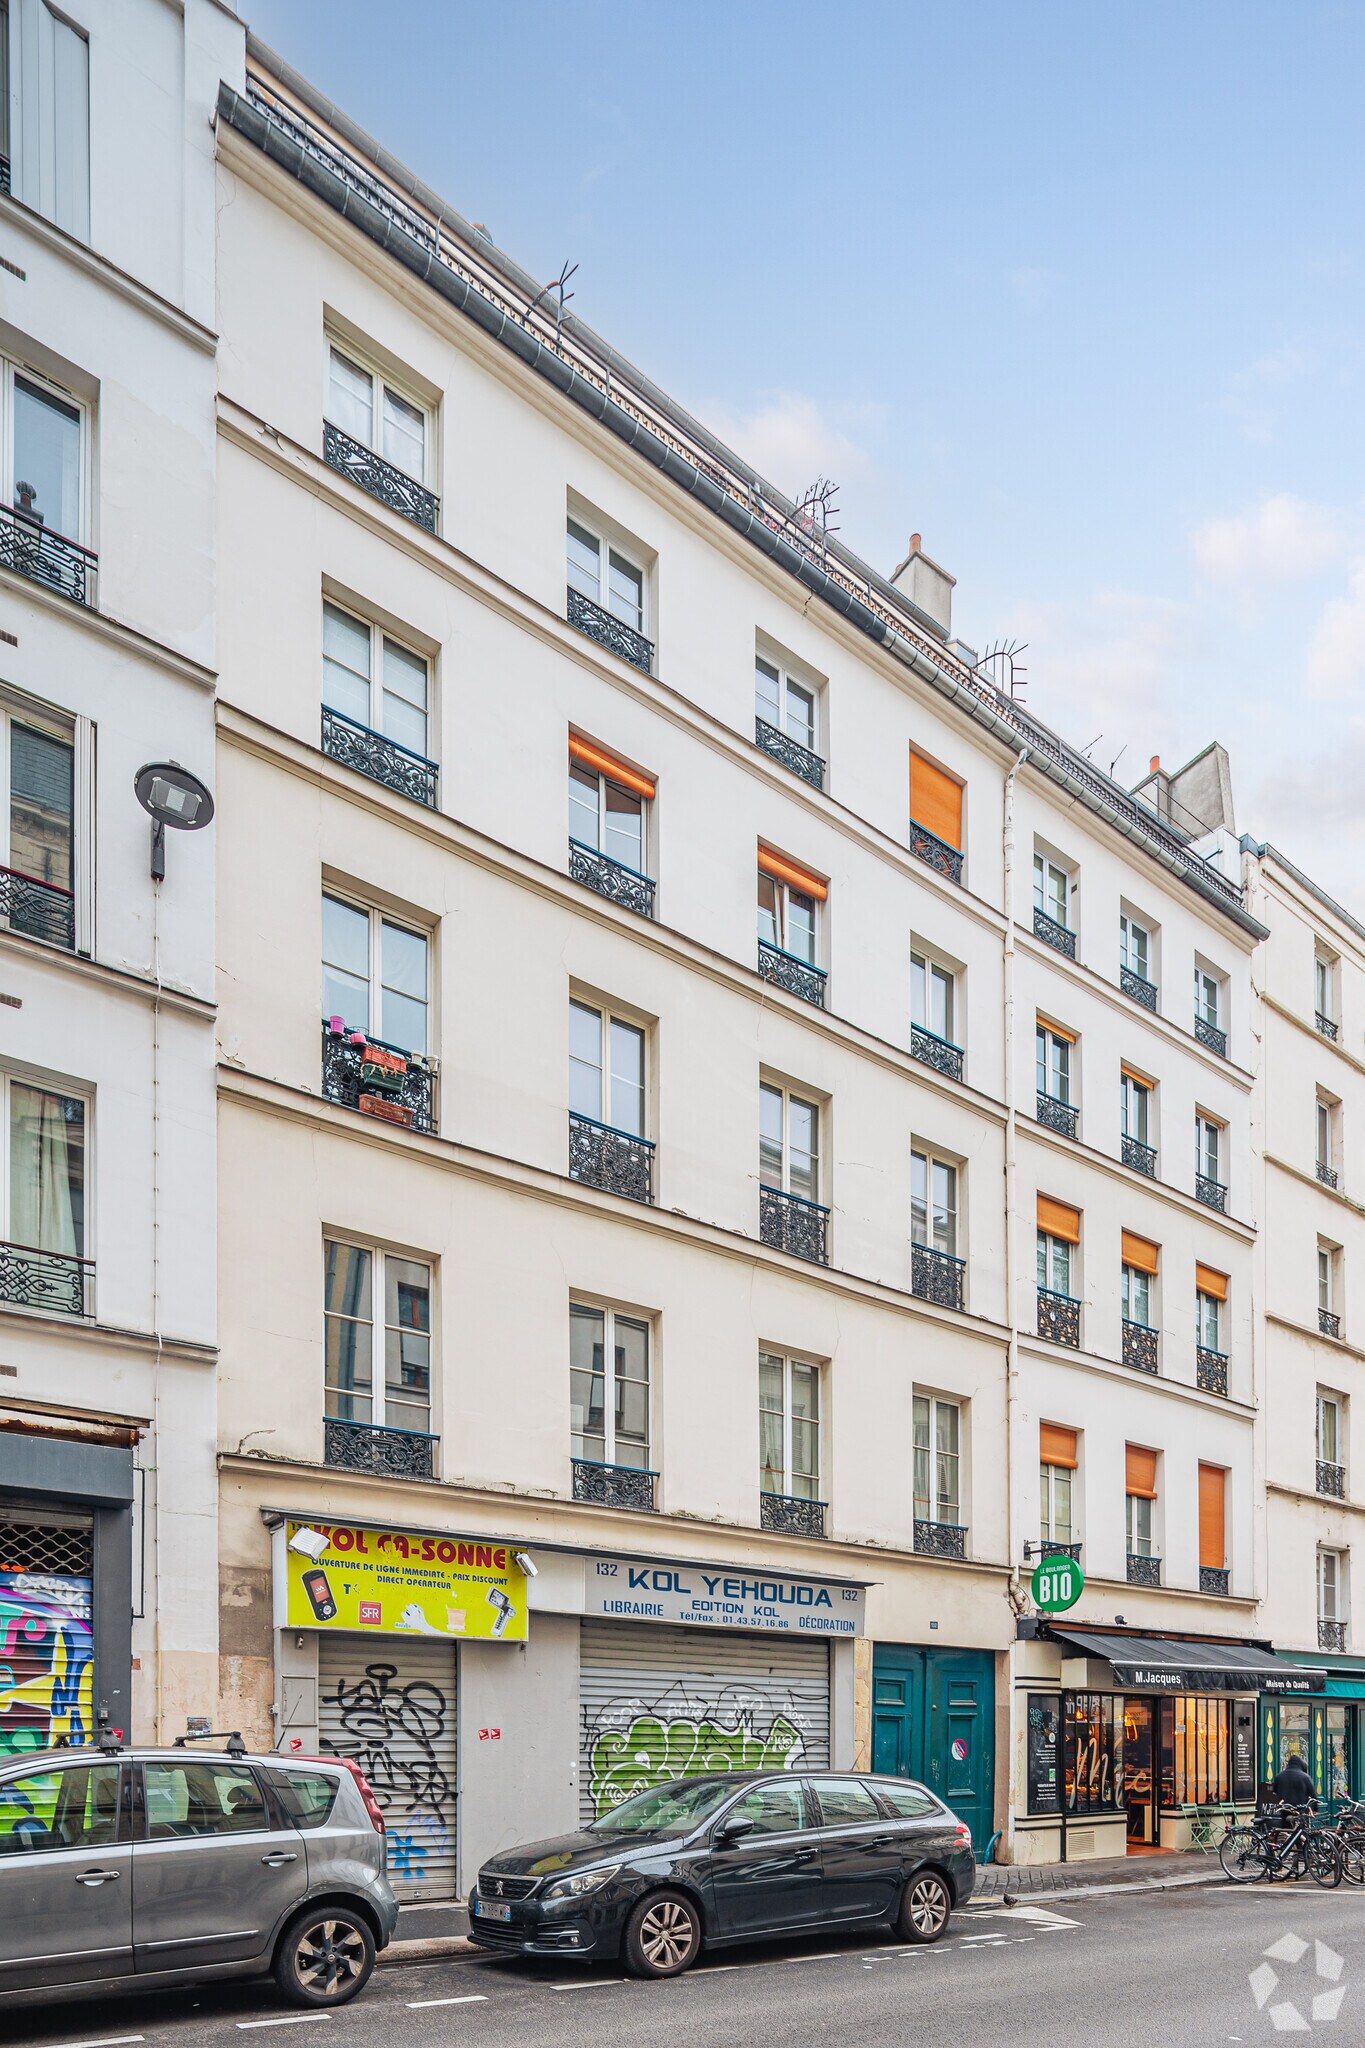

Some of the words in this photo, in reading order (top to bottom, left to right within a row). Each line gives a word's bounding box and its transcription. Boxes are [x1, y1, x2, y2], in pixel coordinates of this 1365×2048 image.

[311, 1557, 361, 1571] OUVERTURE
[363, 1561, 374, 1572] DE
[376, 1564, 400, 1575] LIGNE
[401, 1567, 445, 1579] IMMEDIATE
[452, 1573, 470, 1582] PRIX
[472, 1575, 508, 1586] DISCOUNT
[596, 1562, 618, 1577] 132
[1046, 1564, 1071, 1574] BOULANGER
[376, 1575, 404, 1586] DIRECT
[406, 1578, 452, 1590] OPERATEUR
[628, 1567, 691, 1594] KOL
[701, 1575, 833, 1608] YEHOUDA
[1039, 1572, 1072, 1603] BIO
[841, 1589, 858, 1602] 132
[361, 1607, 379, 1619] SFR
[603, 1599, 664, 1617] LIBRAIRIE
[692, 1599, 744, 1614] EDITION
[753, 1605, 780, 1618] KOL
[722, 1615, 789, 1629] 01.43.57.16.86
[799, 1614, 855, 1632] DÉCORATION
[1135, 1671, 1181, 1686] M.Jacques
